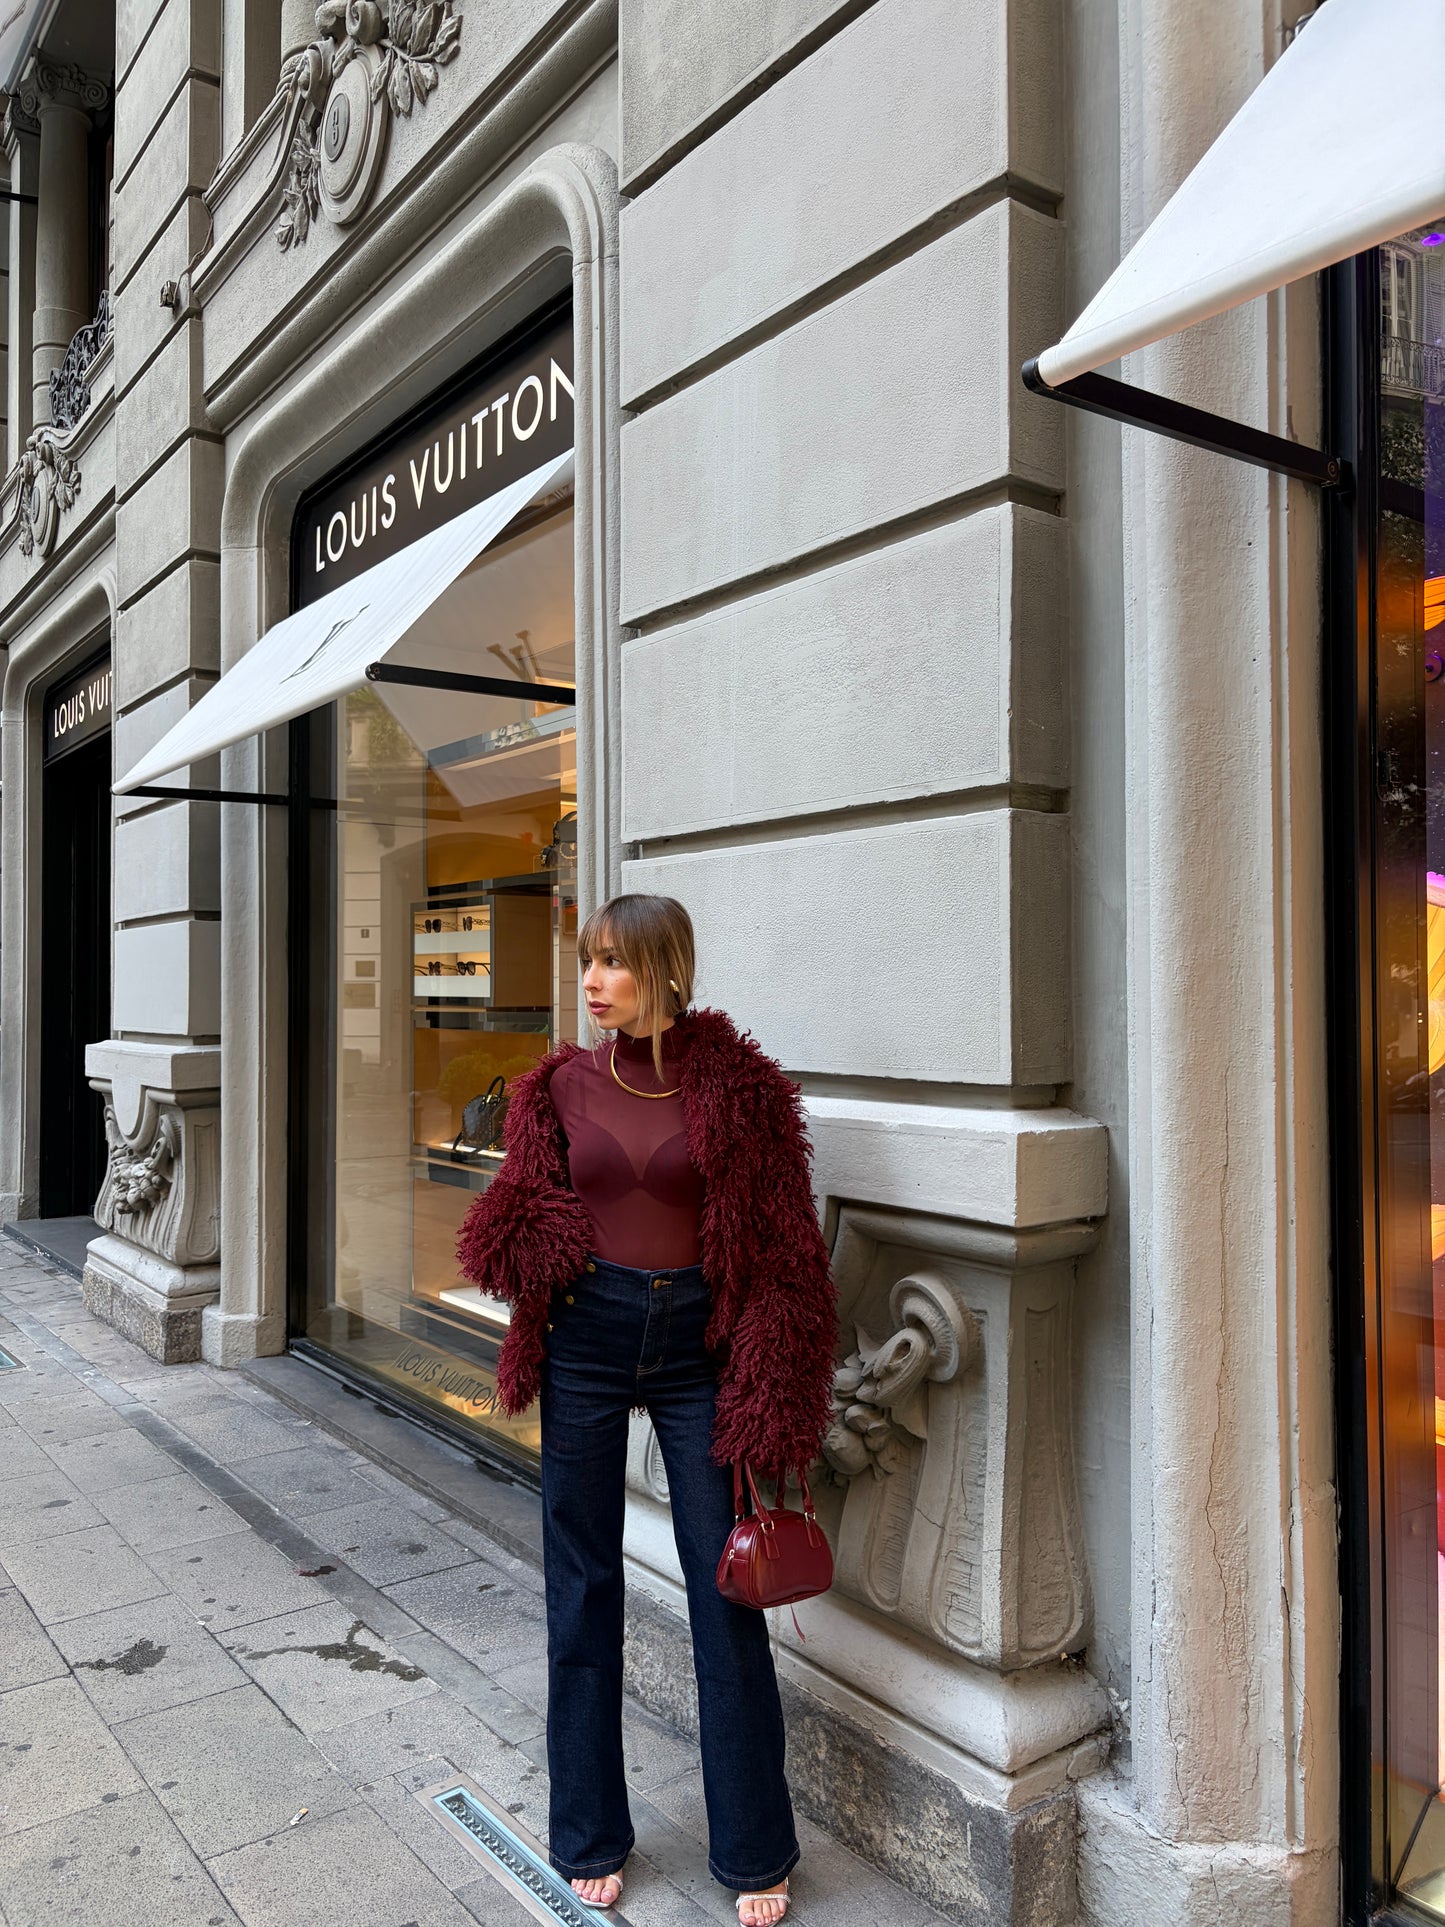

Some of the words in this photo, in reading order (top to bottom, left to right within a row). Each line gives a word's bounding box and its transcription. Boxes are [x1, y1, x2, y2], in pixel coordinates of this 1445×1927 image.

[315, 473, 397, 573] LOUIS
[409, 356, 575, 510] VUITTON
[54, 689, 85, 738] LOUIS
[88, 671, 112, 716] VUI
[396, 1349, 442, 1382] LOUIS
[436, 1367, 502, 1415] VUITTON
